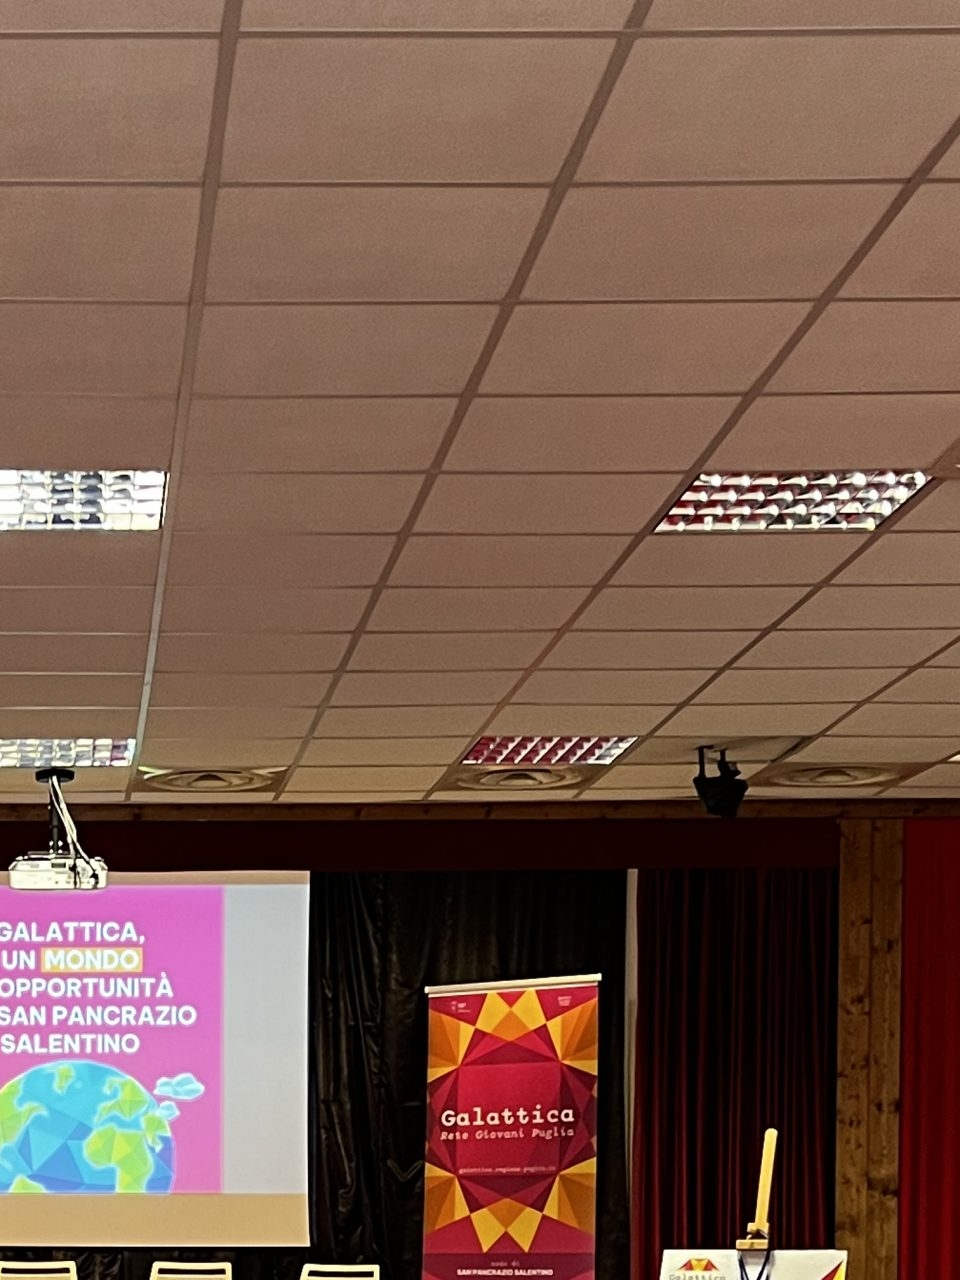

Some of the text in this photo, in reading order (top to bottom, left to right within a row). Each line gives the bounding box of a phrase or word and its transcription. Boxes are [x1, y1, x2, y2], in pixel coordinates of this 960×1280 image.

[1, 949, 141, 971] UN MONDO
[52, 1005, 197, 1027] PANCRAZIO
[0, 1032, 141, 1055] SALENTINO
[441, 1104, 575, 1127] Galattica
[440, 1127, 575, 1141] Rete Giovani Puglia
[456, 1268, 554, 1276] SAN PANCRAZIO SALENTINO
